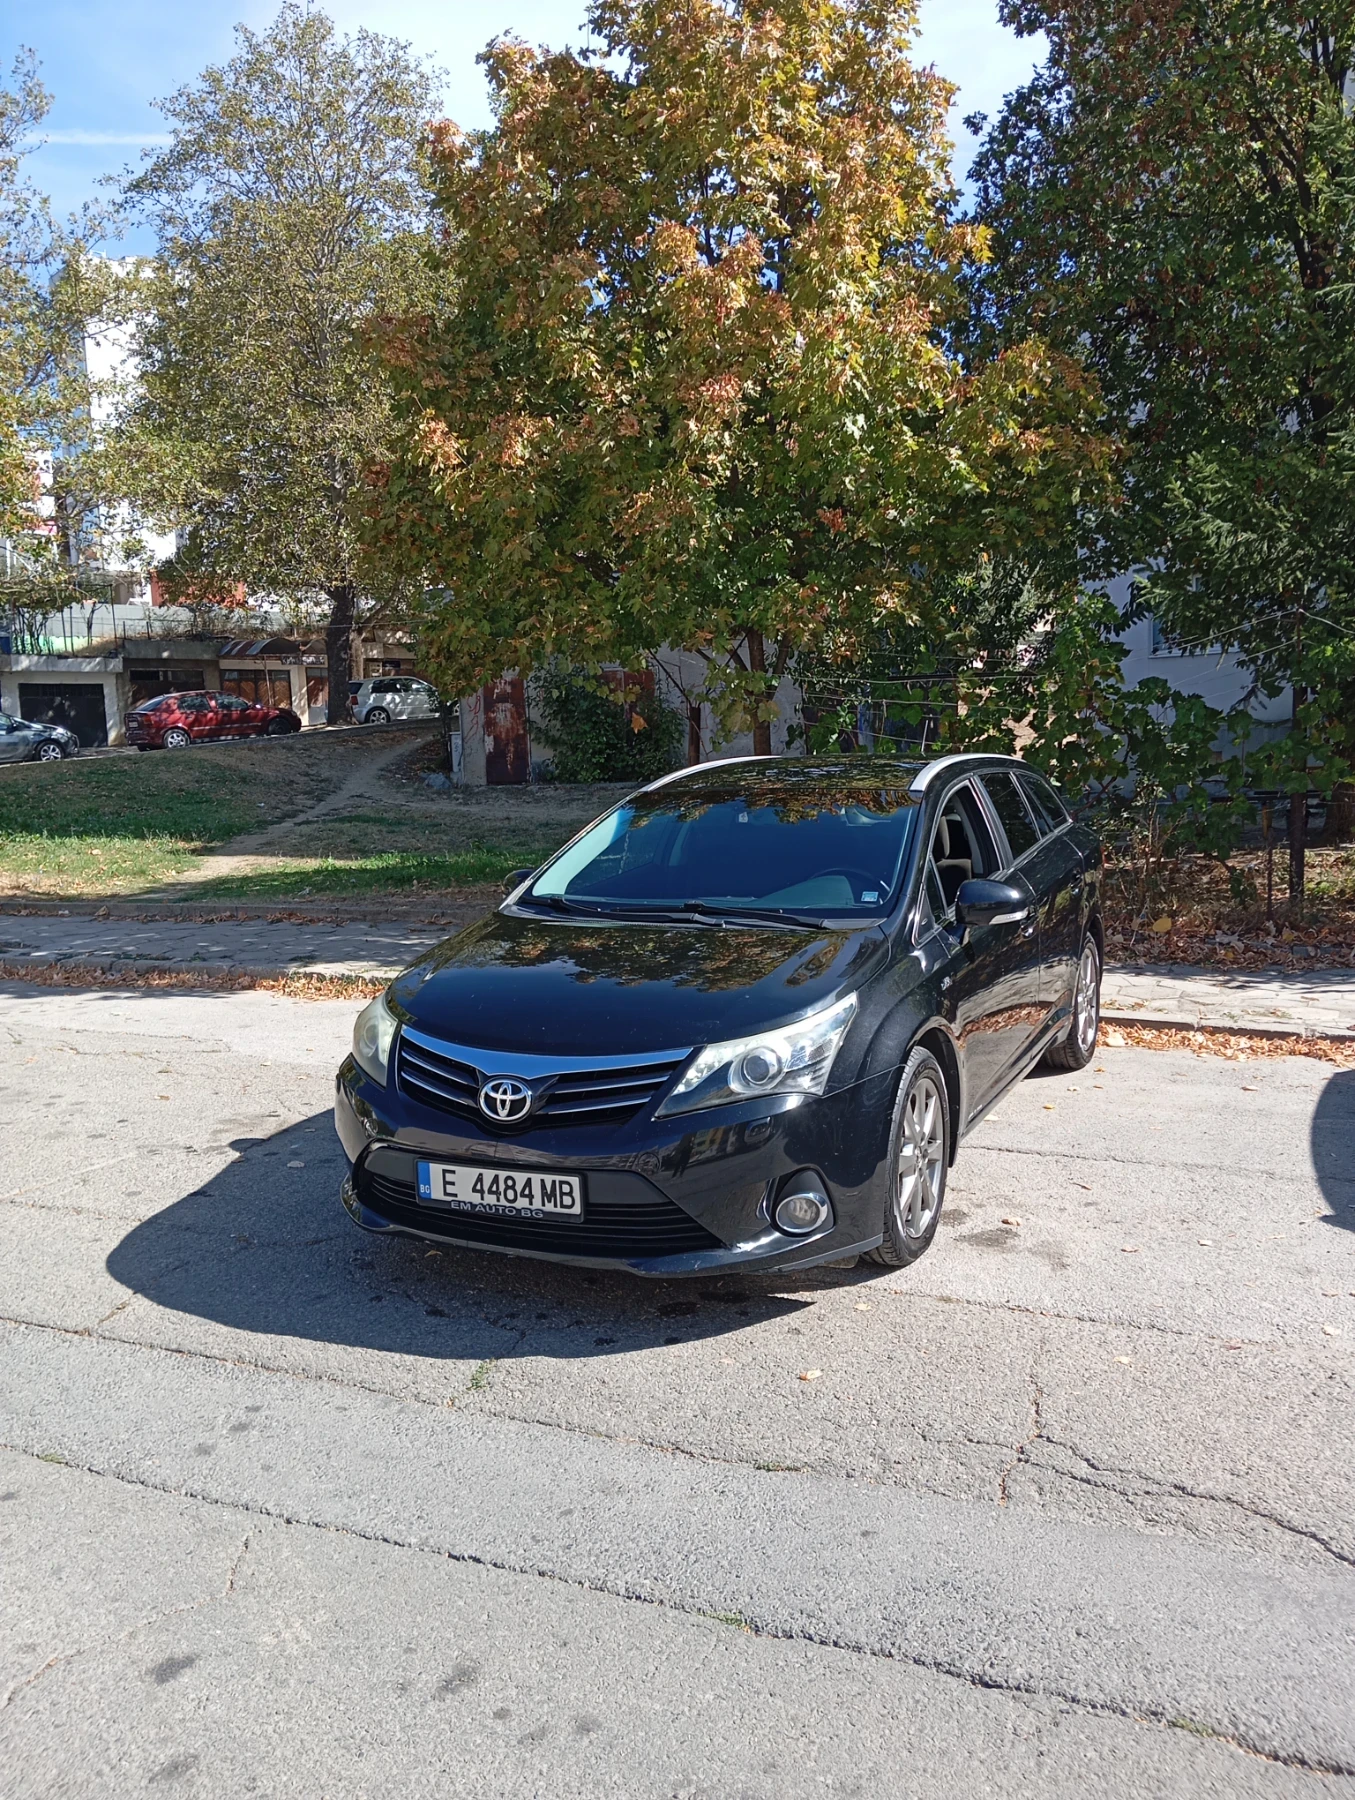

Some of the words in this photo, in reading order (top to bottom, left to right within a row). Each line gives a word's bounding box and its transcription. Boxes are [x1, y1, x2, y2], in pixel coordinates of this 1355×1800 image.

[420, 1184, 430, 1193] BG
[442, 1168, 458, 1198] E
[451, 1201, 471, 1211] EM
[475, 1204, 516, 1215] AUTO
[521, 1209, 544, 1218] BG
